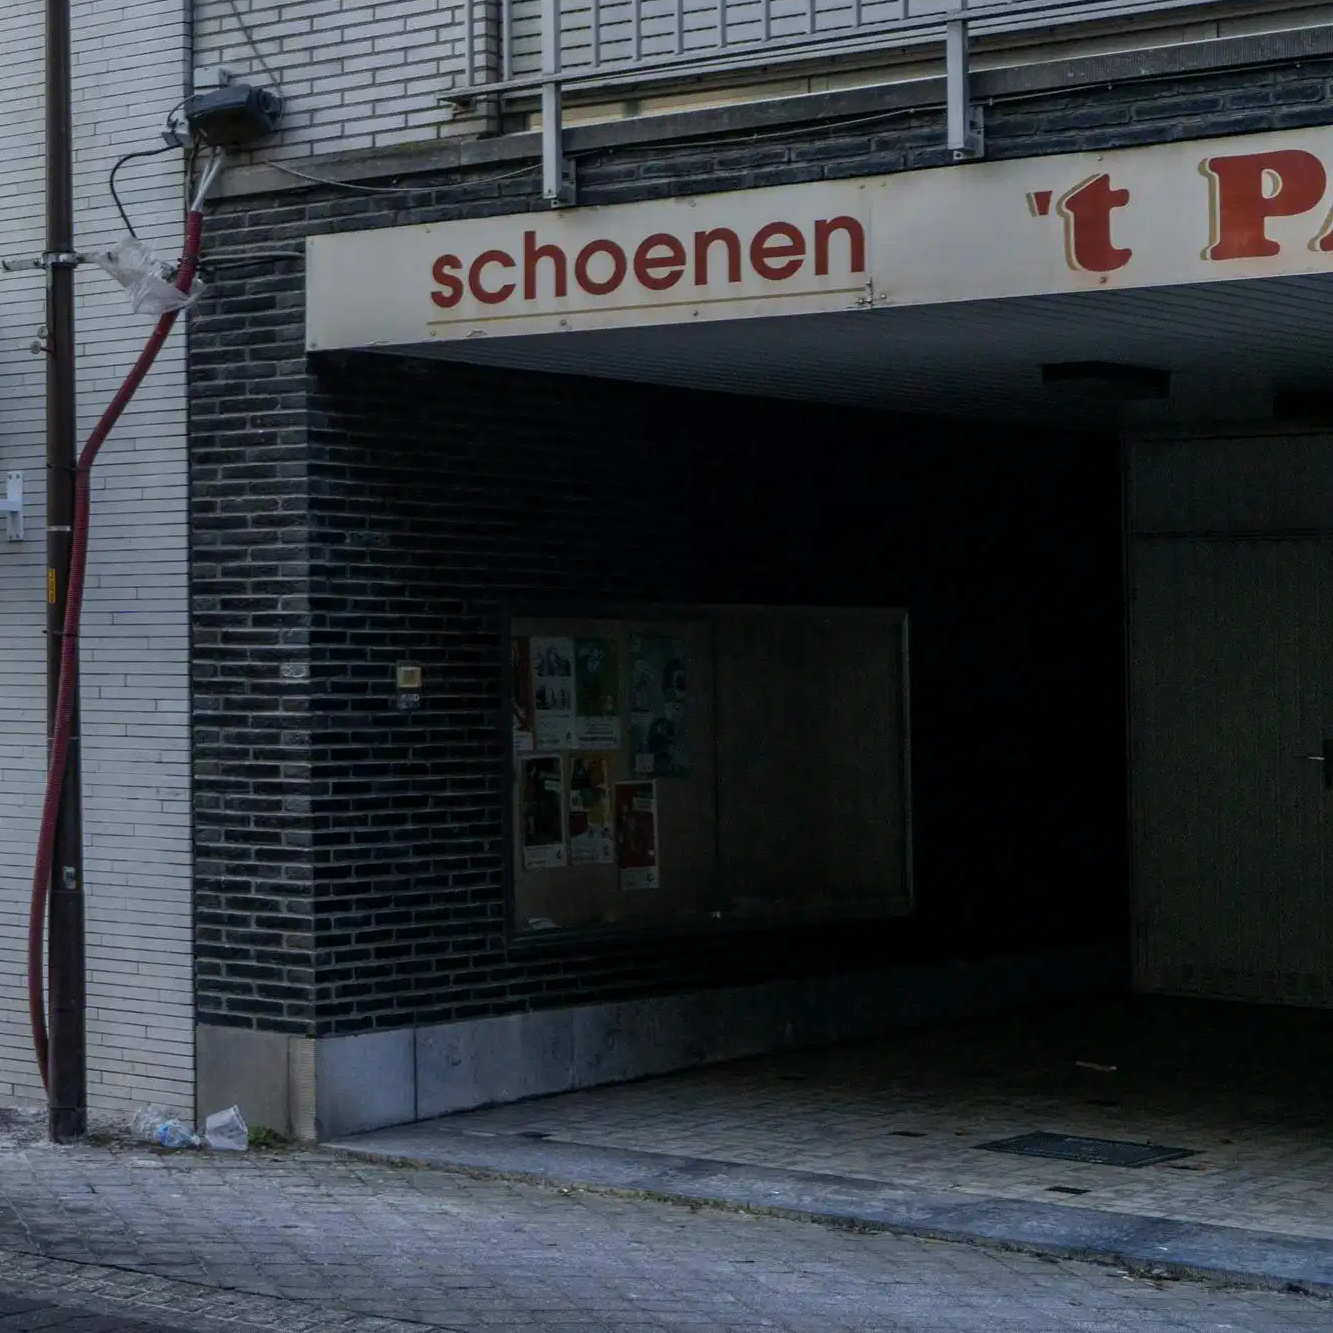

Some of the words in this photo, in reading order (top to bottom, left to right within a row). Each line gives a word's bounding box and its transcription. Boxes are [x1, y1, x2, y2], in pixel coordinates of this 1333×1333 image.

[430, 215, 865, 309] schoenen
[1026, 173, 1132, 273] 't
[1198, 150, 1333, 261] P
